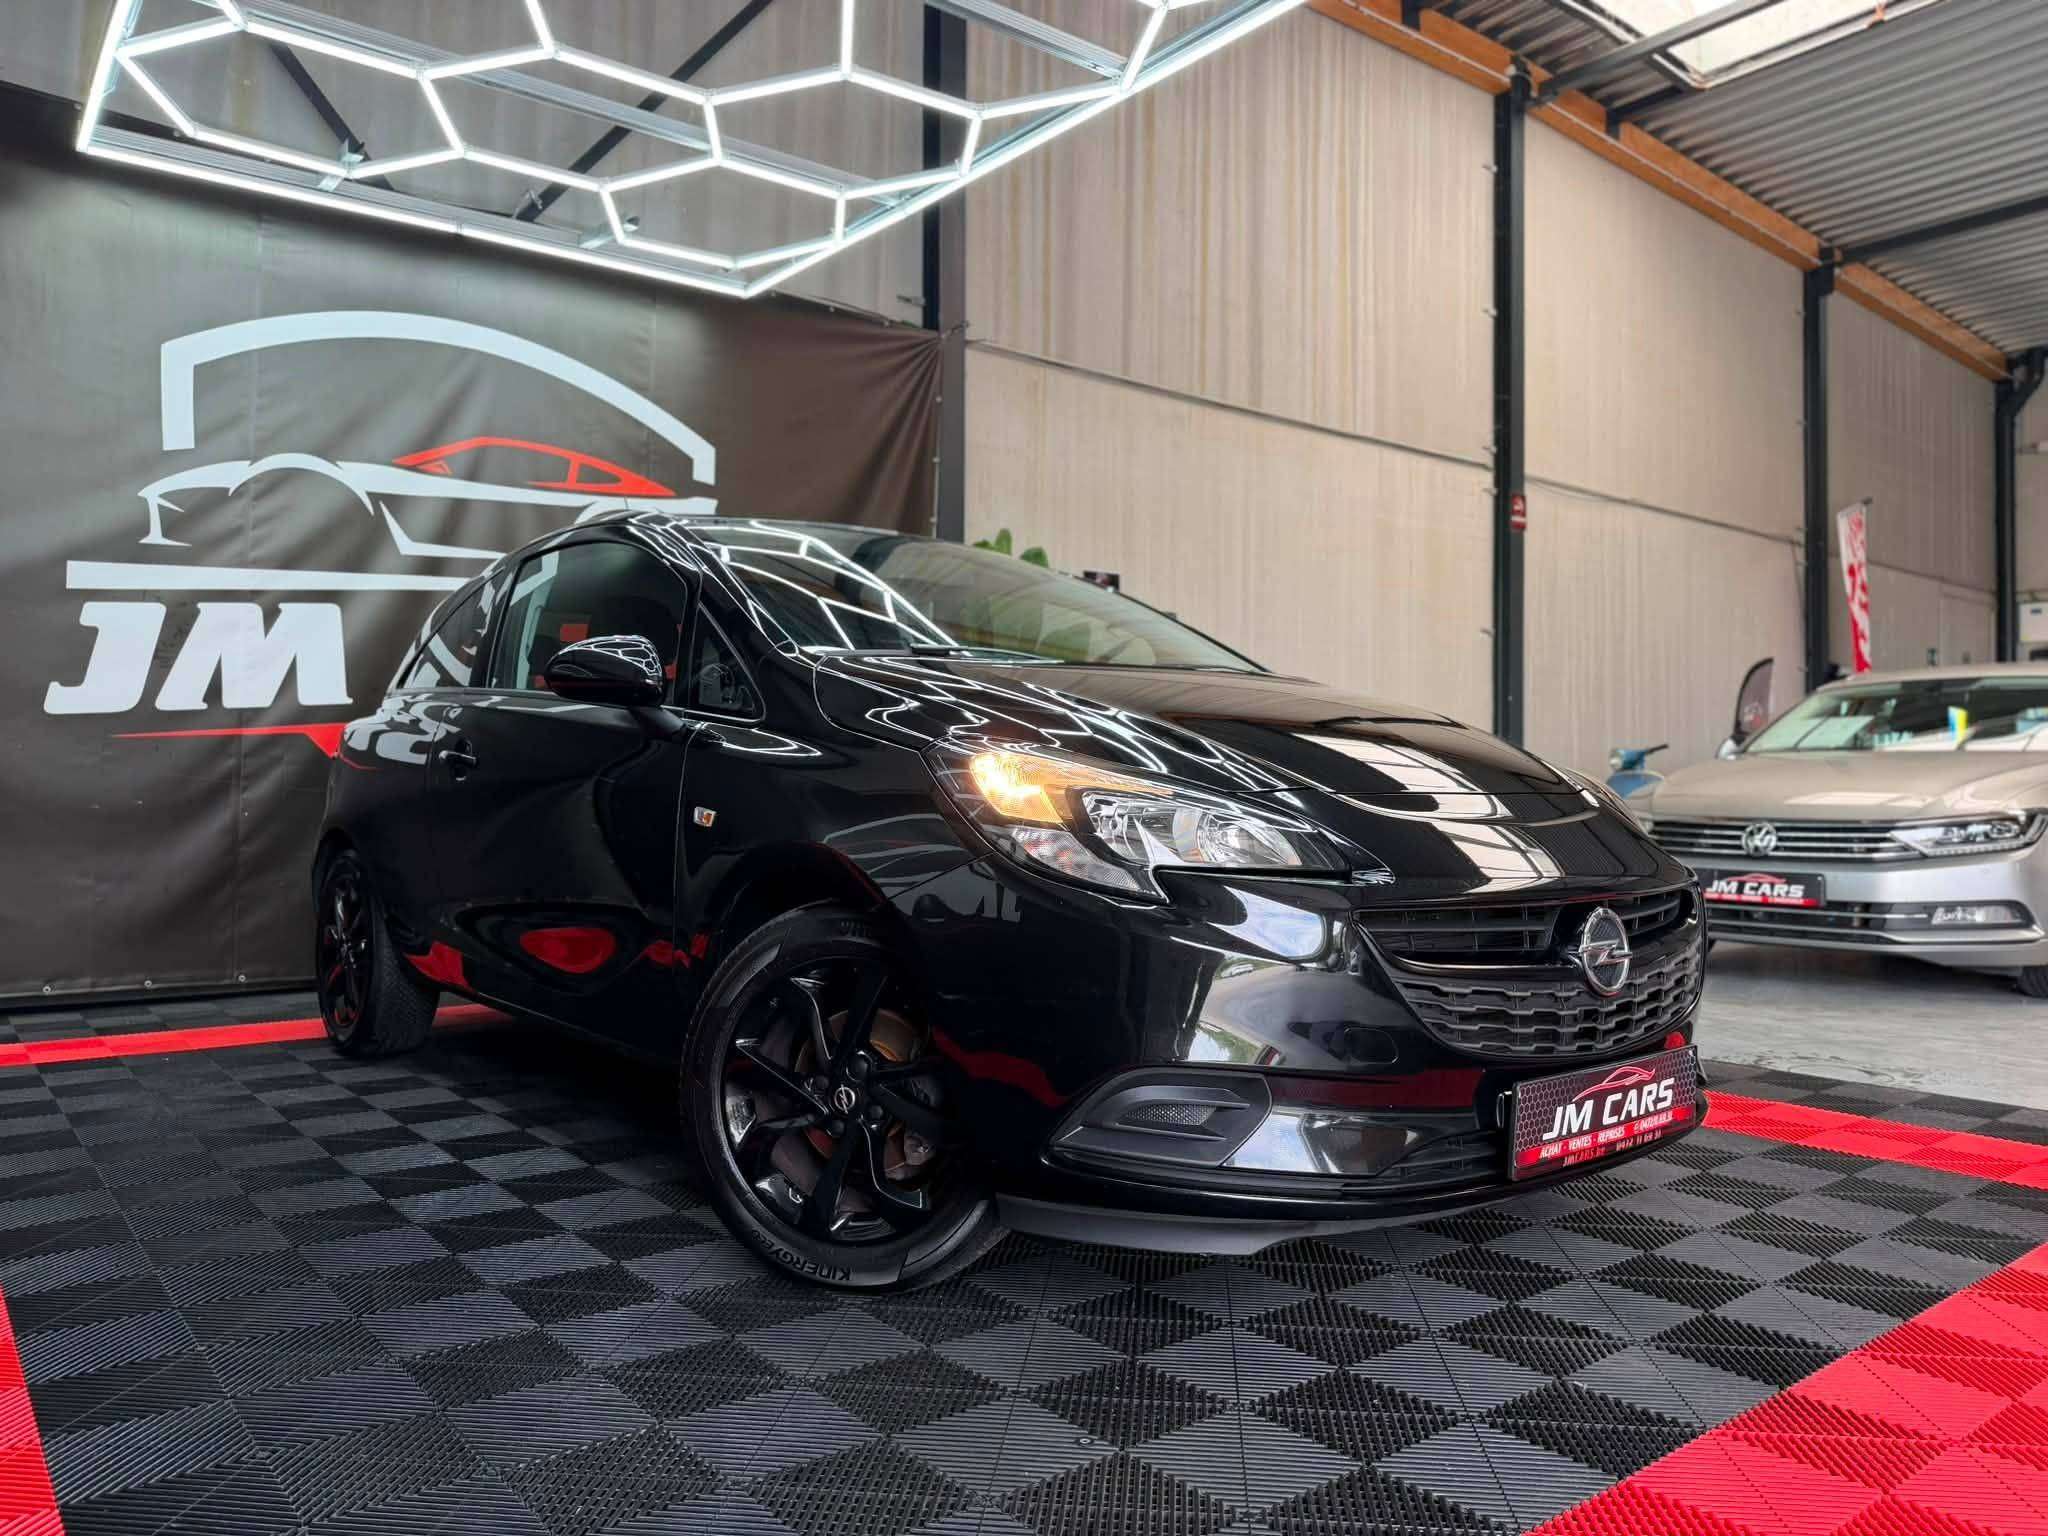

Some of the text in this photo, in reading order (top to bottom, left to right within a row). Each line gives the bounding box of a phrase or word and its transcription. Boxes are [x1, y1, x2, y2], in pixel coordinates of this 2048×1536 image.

[44, 601, 353, 714] JM
[1705, 880, 1805, 898] JM CARS
[1542, 1099, 1594, 1141] JM
[1602, 1077, 1675, 1126] CARS
[1539, 1142, 1563, 1160] ACHAT
[1568, 1133, 1592, 1151] VENTES
[768, 1247, 849, 1280] KINERGY
